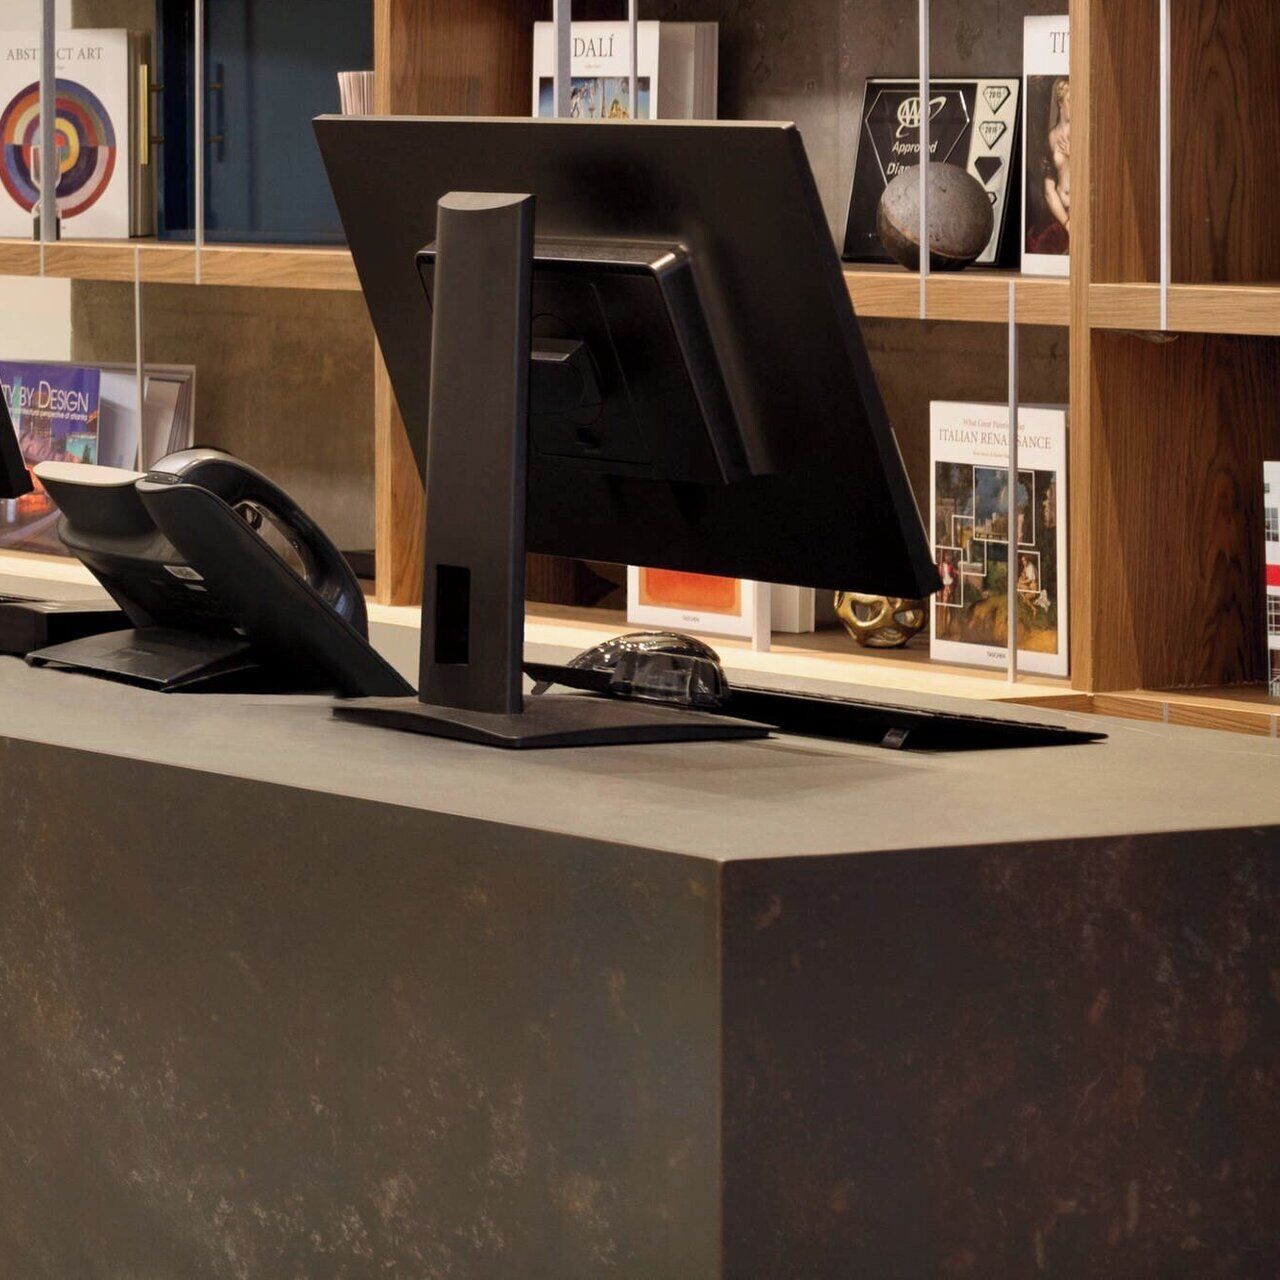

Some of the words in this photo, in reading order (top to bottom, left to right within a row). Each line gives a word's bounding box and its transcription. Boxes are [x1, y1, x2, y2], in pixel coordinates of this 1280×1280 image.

[6, 47, 75, 62] ABSTCT
[77, 47, 104, 61] ART
[573, 33, 615, 57] DALÍ
[892, 141, 939, 155] Approd
[20, 386, 35, 408] BY
[939, 428, 978, 445] ITALIAN
[980, 432, 1052, 450] RENASANCE
